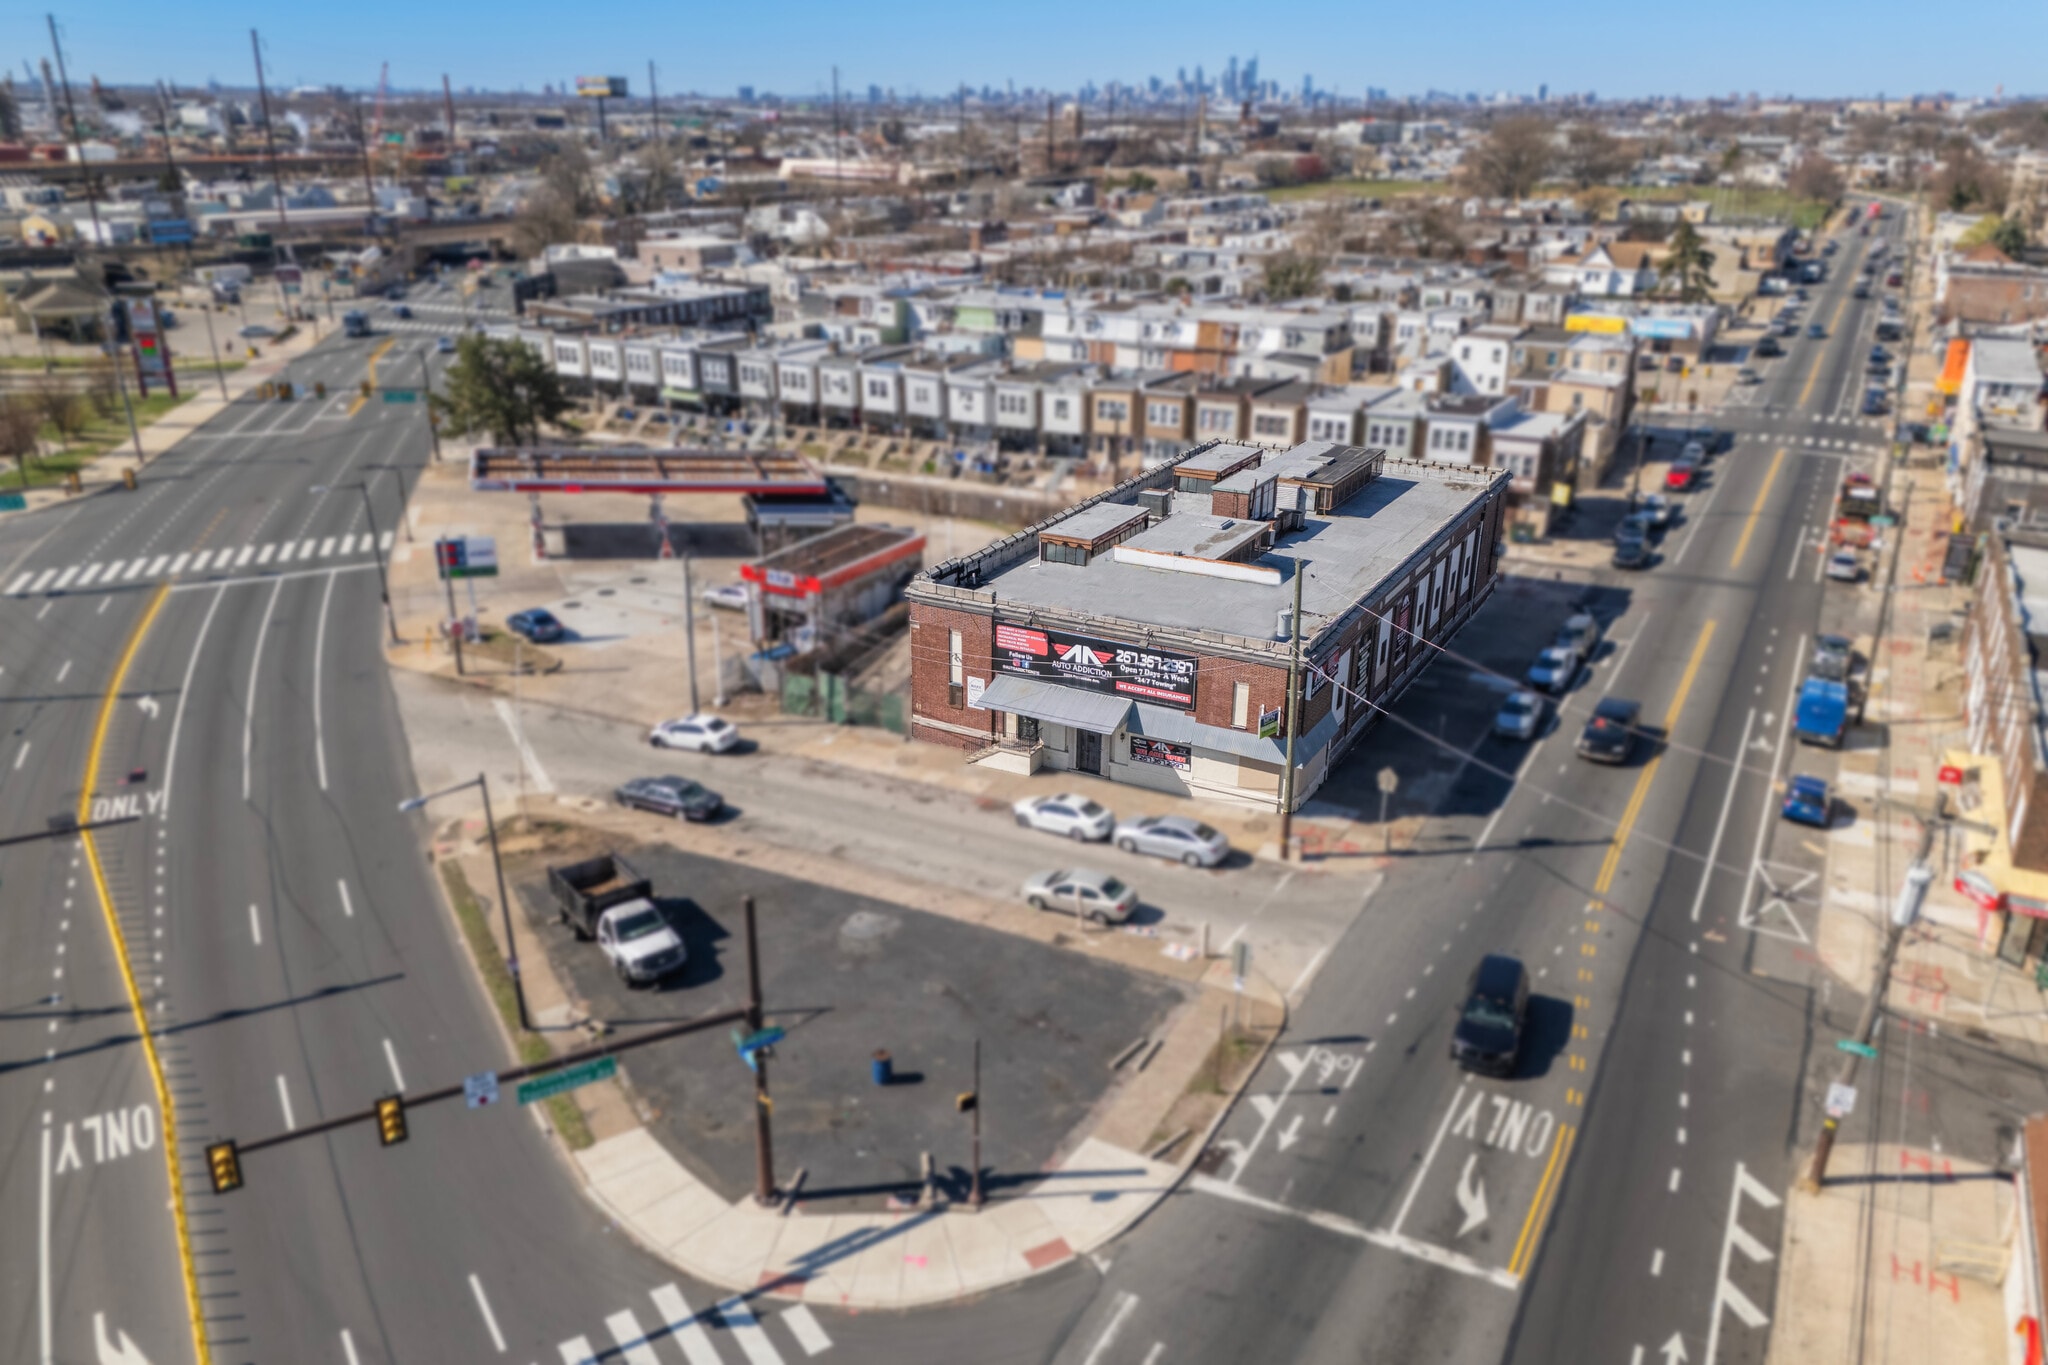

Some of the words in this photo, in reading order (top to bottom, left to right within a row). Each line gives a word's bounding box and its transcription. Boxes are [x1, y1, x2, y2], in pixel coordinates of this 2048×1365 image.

[1009, 651, 1025, 659] Follow
[1052, 660, 1071, 670] AUTO
[1073, 665, 1112, 678] ADDICTION
[1120, 664, 1137, 673] Open
[1144, 669, 1161, 678] Days
[1170, 674, 1190, 684] Week
[1127, 685, 1146, 693] ACCEPT
[1156, 691, 1189, 701] INSURANCES
[92, 790, 162, 822] ONLY
[1452, 1090, 1554, 1158] ONLY
[56, 1103, 155, 1174] ONLY
